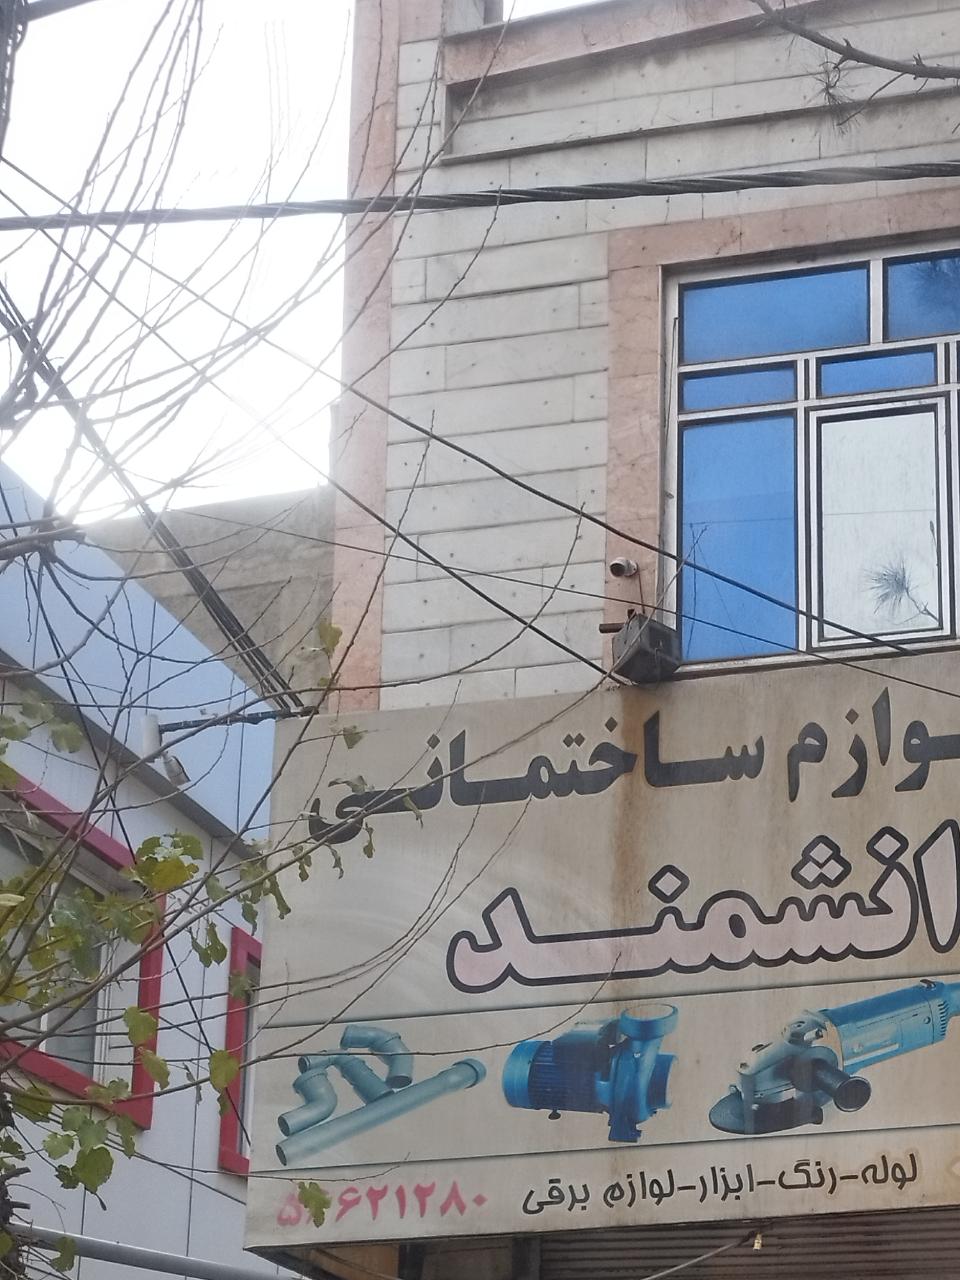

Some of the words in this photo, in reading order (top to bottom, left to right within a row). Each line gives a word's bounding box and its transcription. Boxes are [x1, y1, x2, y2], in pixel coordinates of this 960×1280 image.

[308, 711, 764, 844] ساختمانی
[276, 1180, 489, 1227] ۵۶۲۱۲۸۰
[523, 1174, 590, 1215] برقی
